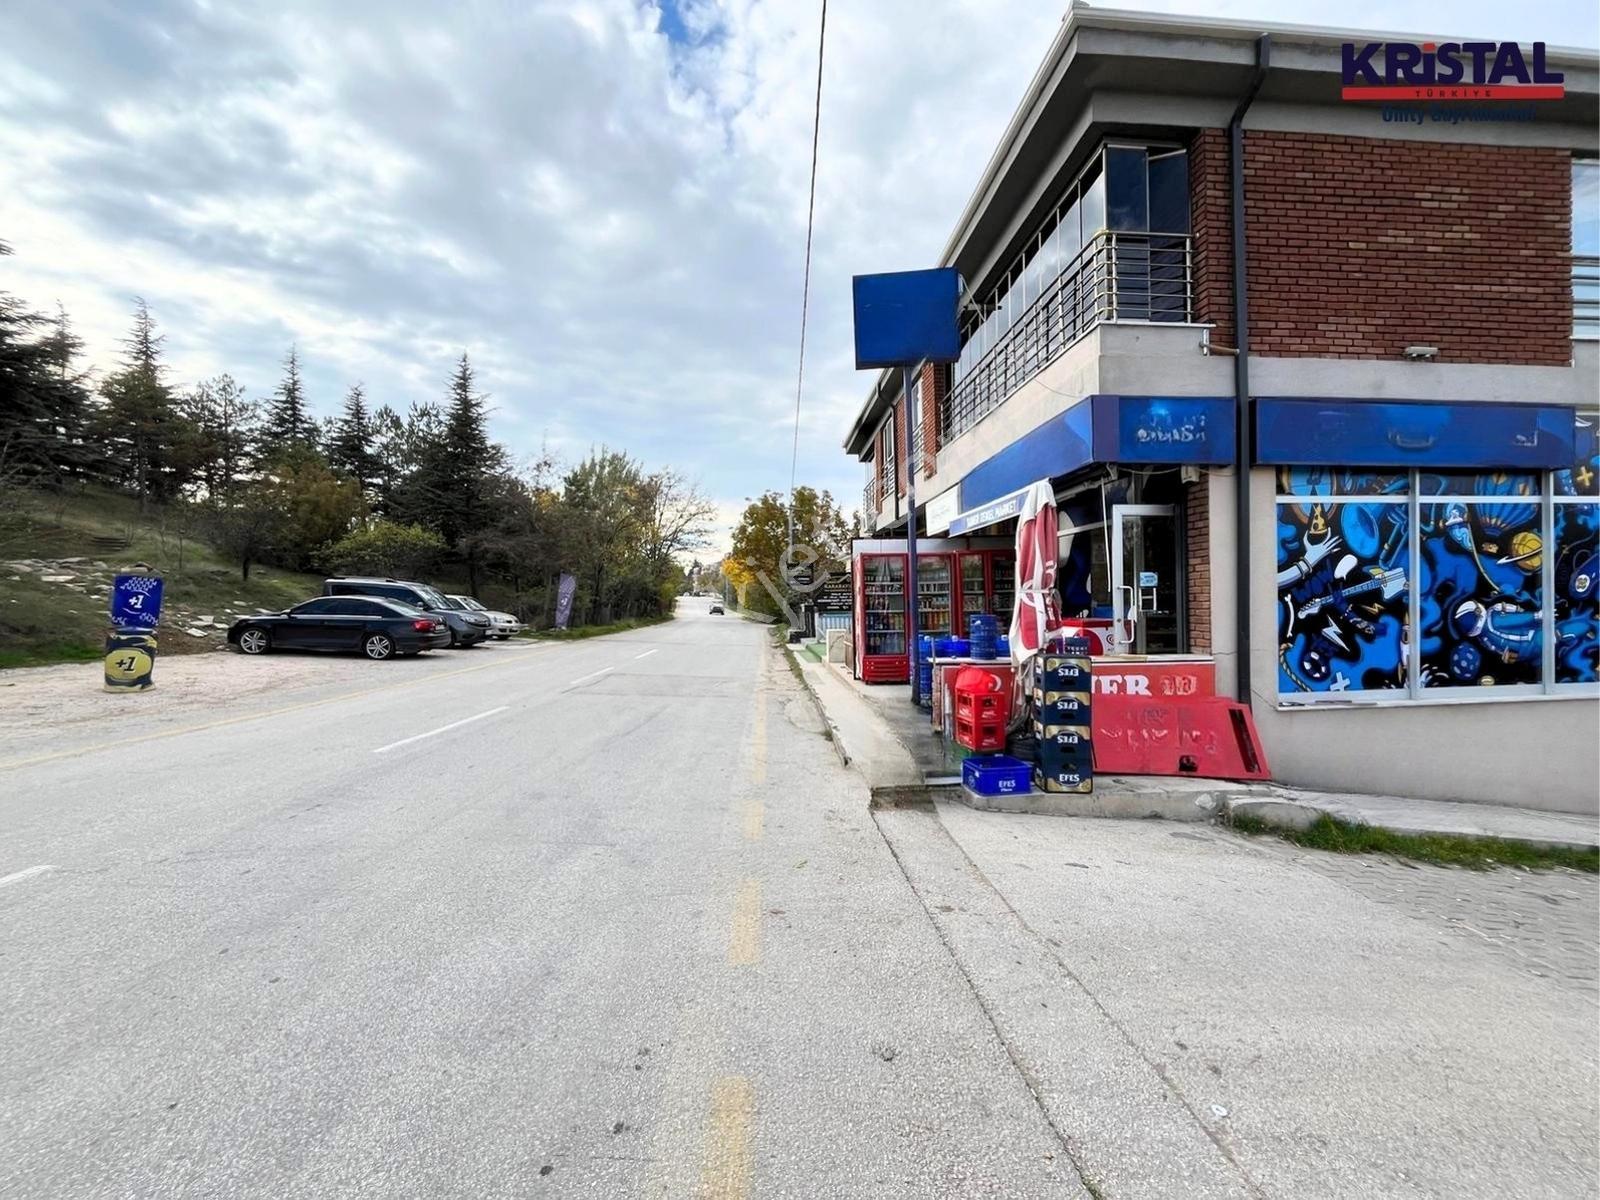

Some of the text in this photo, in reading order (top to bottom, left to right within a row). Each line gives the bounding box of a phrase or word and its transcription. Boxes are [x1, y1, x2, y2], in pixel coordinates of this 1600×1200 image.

[128, 594, 145, 609] +1
[115, 656, 137, 672] +1
[1057, 668, 1079, 677] EFES
[1056, 701, 1078, 710] EFES
[1057, 735, 1078, 744] EFES
[1058, 773, 1080, 782] EFES
[998, 779, 1016, 789] EFES
